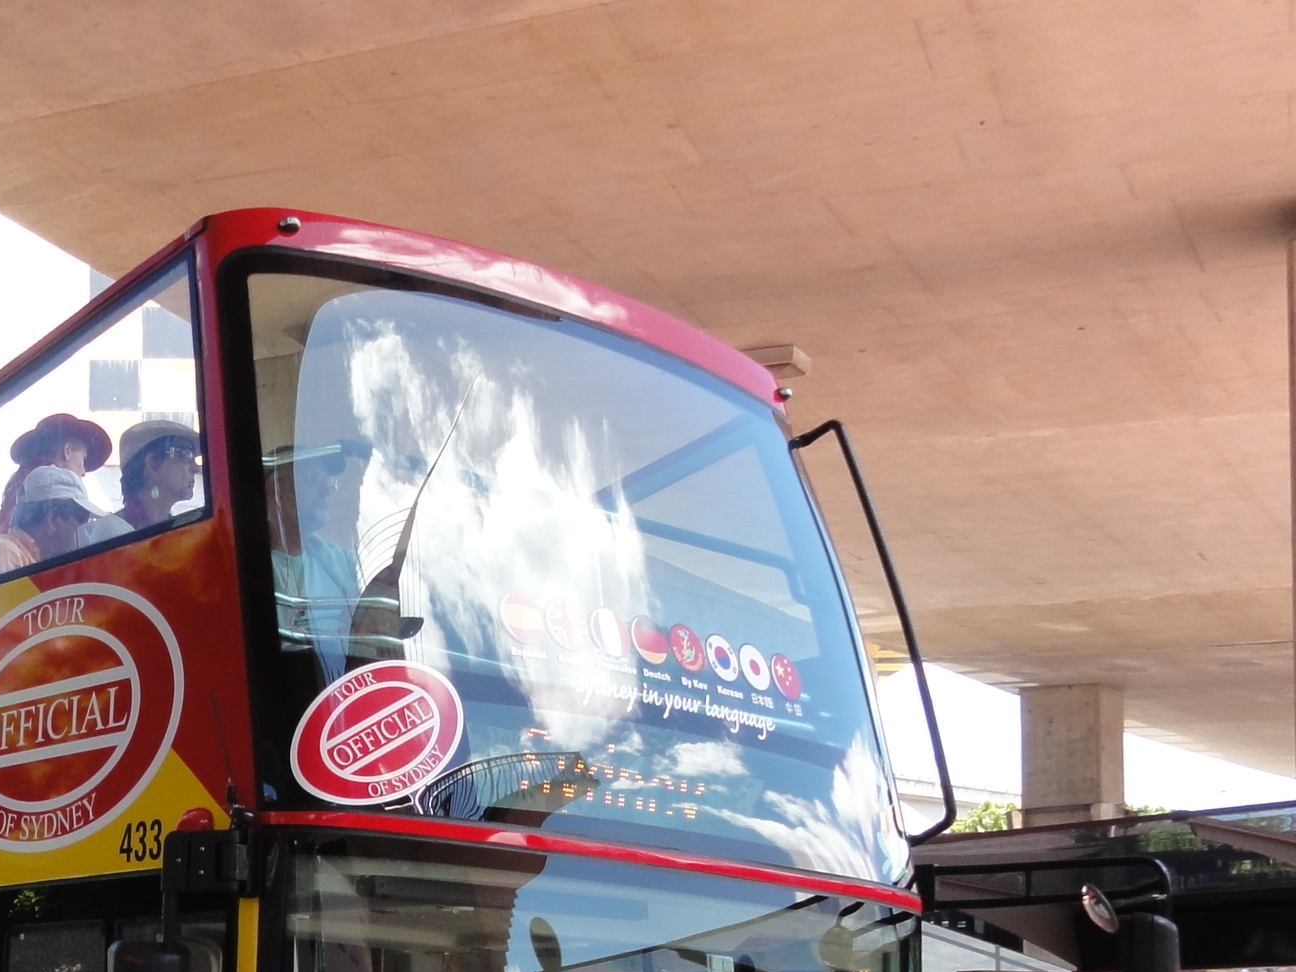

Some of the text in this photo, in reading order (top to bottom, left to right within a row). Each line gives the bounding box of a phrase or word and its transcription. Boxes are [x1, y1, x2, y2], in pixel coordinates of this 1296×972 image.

[23, 597, 85, 637] TOUR
[331, 671, 377, 702] TOUR
[643, 668, 671, 682] Deutch
[717, 685, 743, 699] Korean
[333, 700, 433, 767] OFFICIAL
[642, 683, 663, 704] in
[663, 692, 702, 719] your
[705, 694, 776, 740] language
[368, 744, 445, 798] OF SYDNEY
[19, 792, 98, 841] SYDNEY
[119, 818, 162, 863] 433
